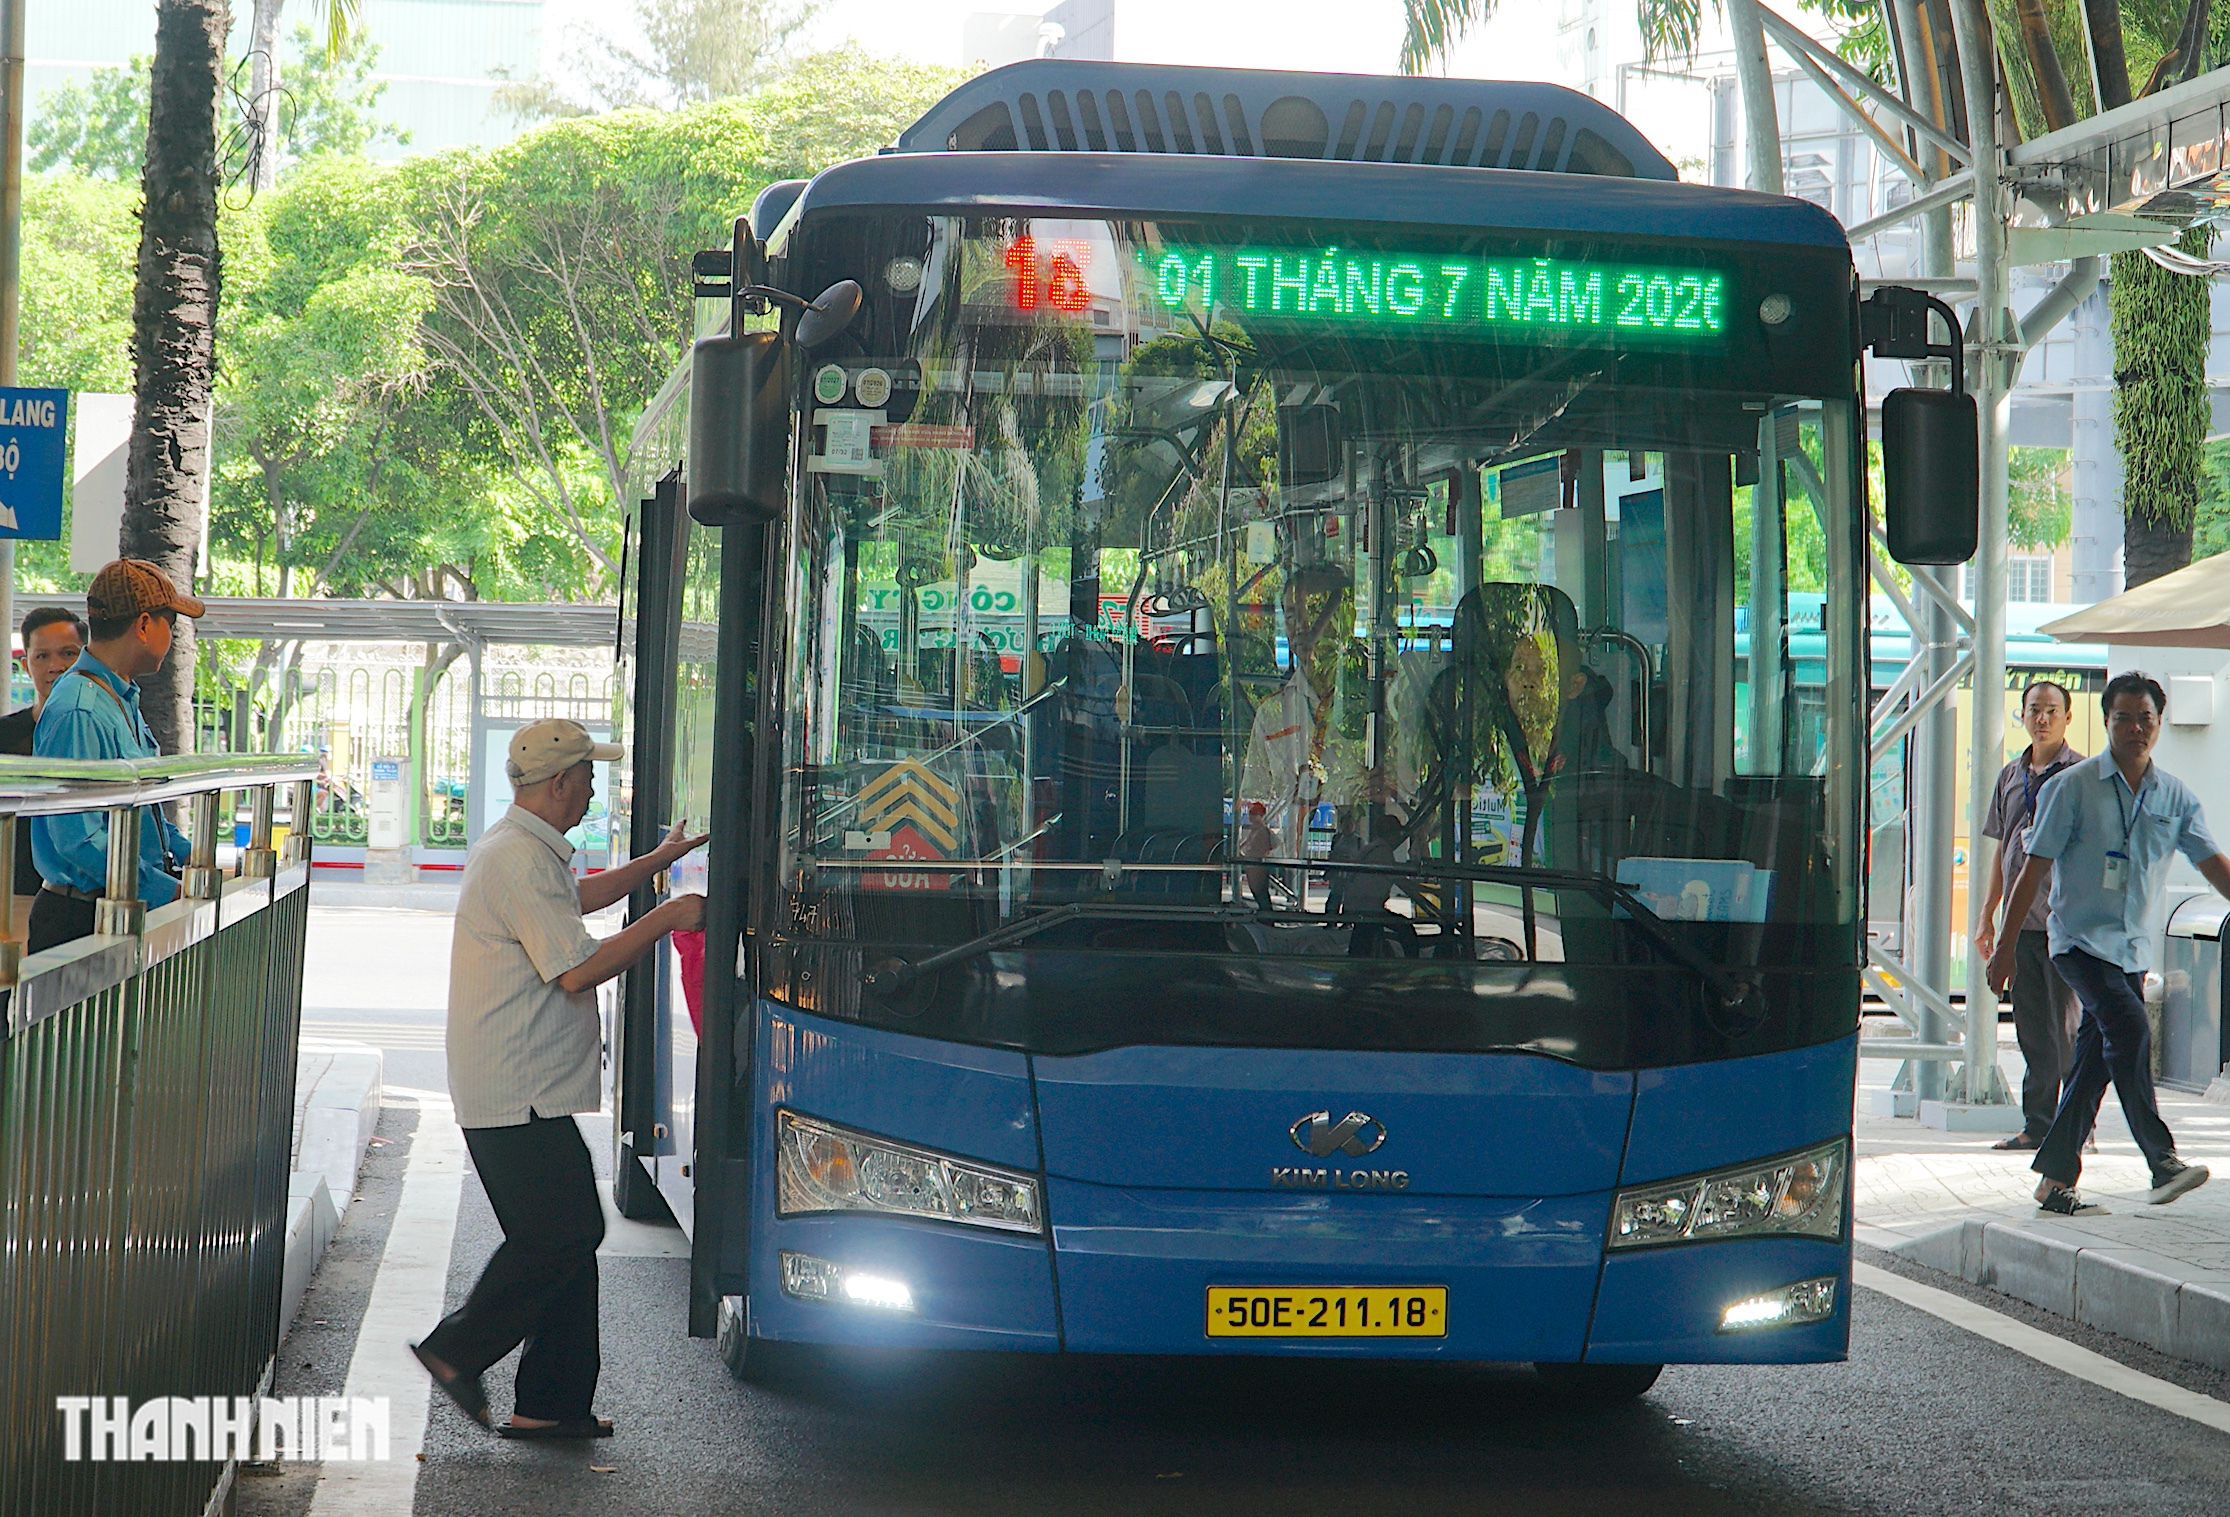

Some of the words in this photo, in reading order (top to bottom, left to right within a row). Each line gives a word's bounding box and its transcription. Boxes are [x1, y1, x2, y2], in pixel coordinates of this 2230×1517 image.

[1006, 237, 1091, 310] 18
[1158, 253, 1213, 308] 01
[1237, 246, 1424, 316] THÁNG
[1440, 265, 1468, 318] 7
[1486, 256, 1602, 325] NĂM
[0, 398, 55, 428] LANG
[1272, 1167, 1328, 1188] KIM
[1333, 1169, 1410, 1190] LONG
[1228, 1297, 1426, 1328] 50E-211.18
